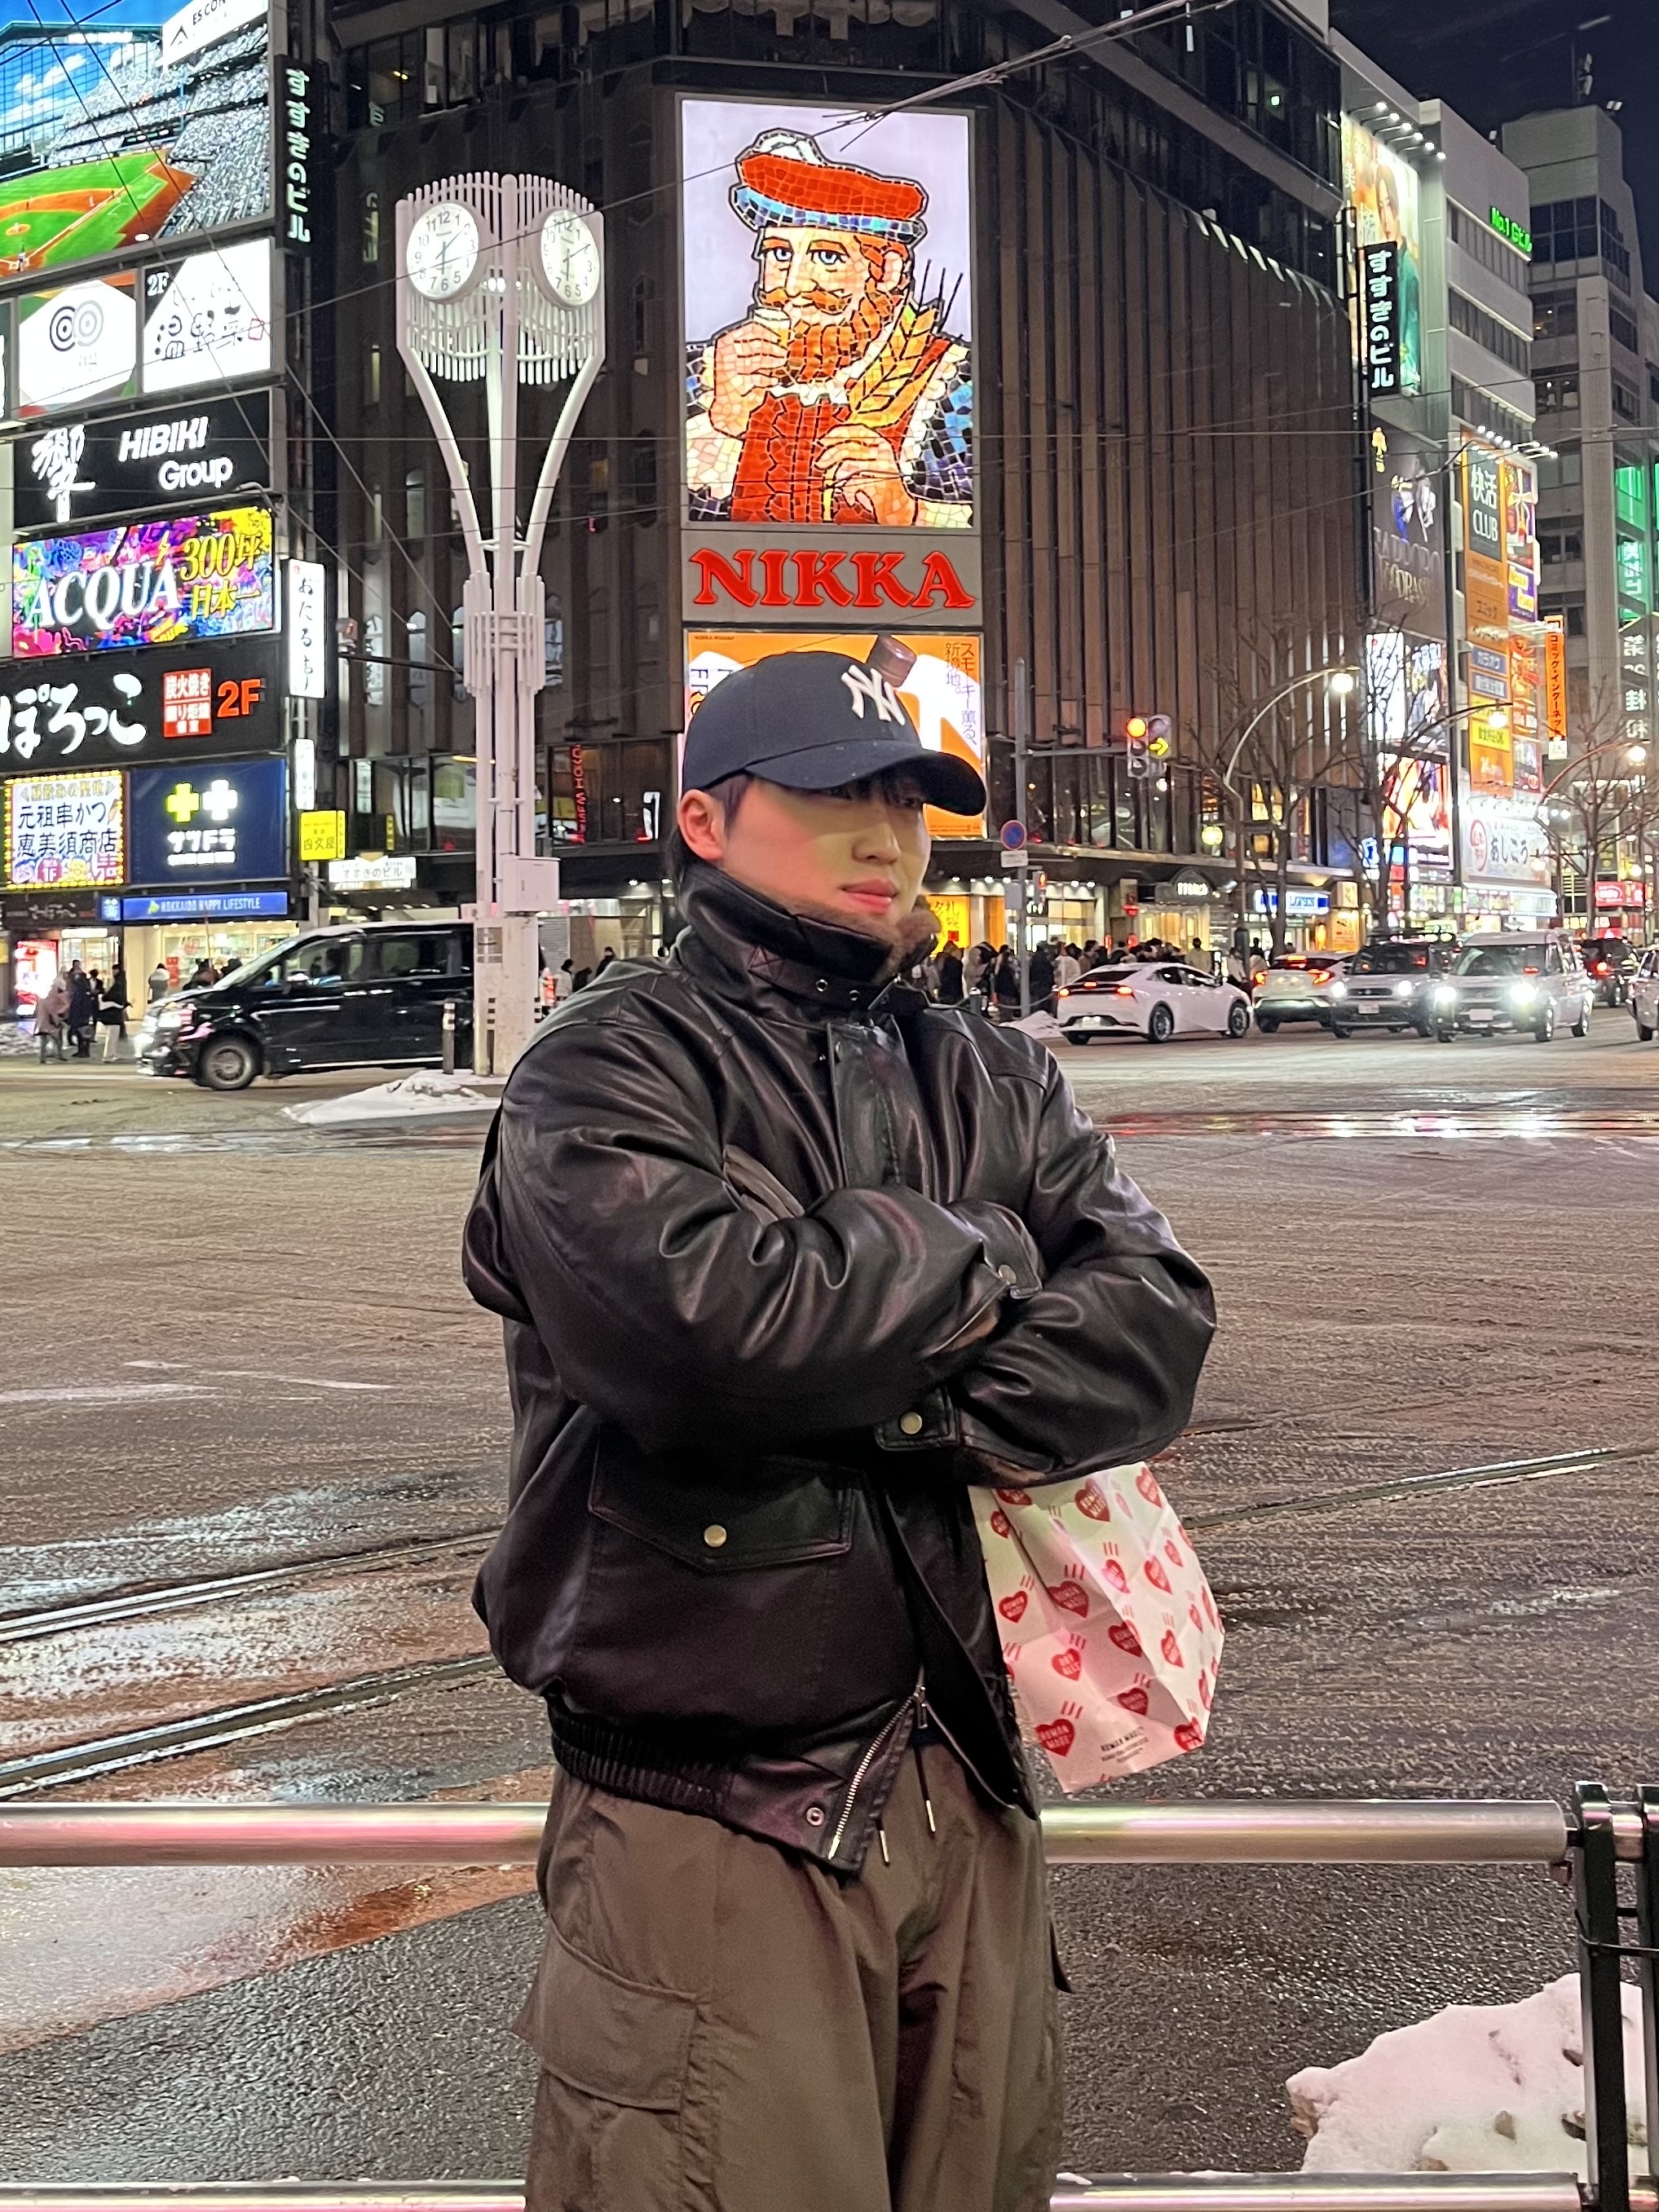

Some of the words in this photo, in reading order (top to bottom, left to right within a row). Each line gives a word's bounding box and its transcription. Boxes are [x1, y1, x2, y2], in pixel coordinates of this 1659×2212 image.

[118, 416, 210, 462] HIBIKI
[158, 456, 234, 491] Group
[1472, 509, 1499, 542] CLUB
[179, 531, 263, 581] 300坪
[24, 557, 182, 630] ACQUA
[689, 548, 976, 609] NIKKA
[192, 579, 261, 620] 日本一
[217, 678, 261, 717] 2F
[841, 664, 907, 725] NY
[18, 802, 107, 829] 元祖串かつ
[17, 828, 117, 857] 恵美須商店
[223, 897, 261, 910] LIFESTYLE
